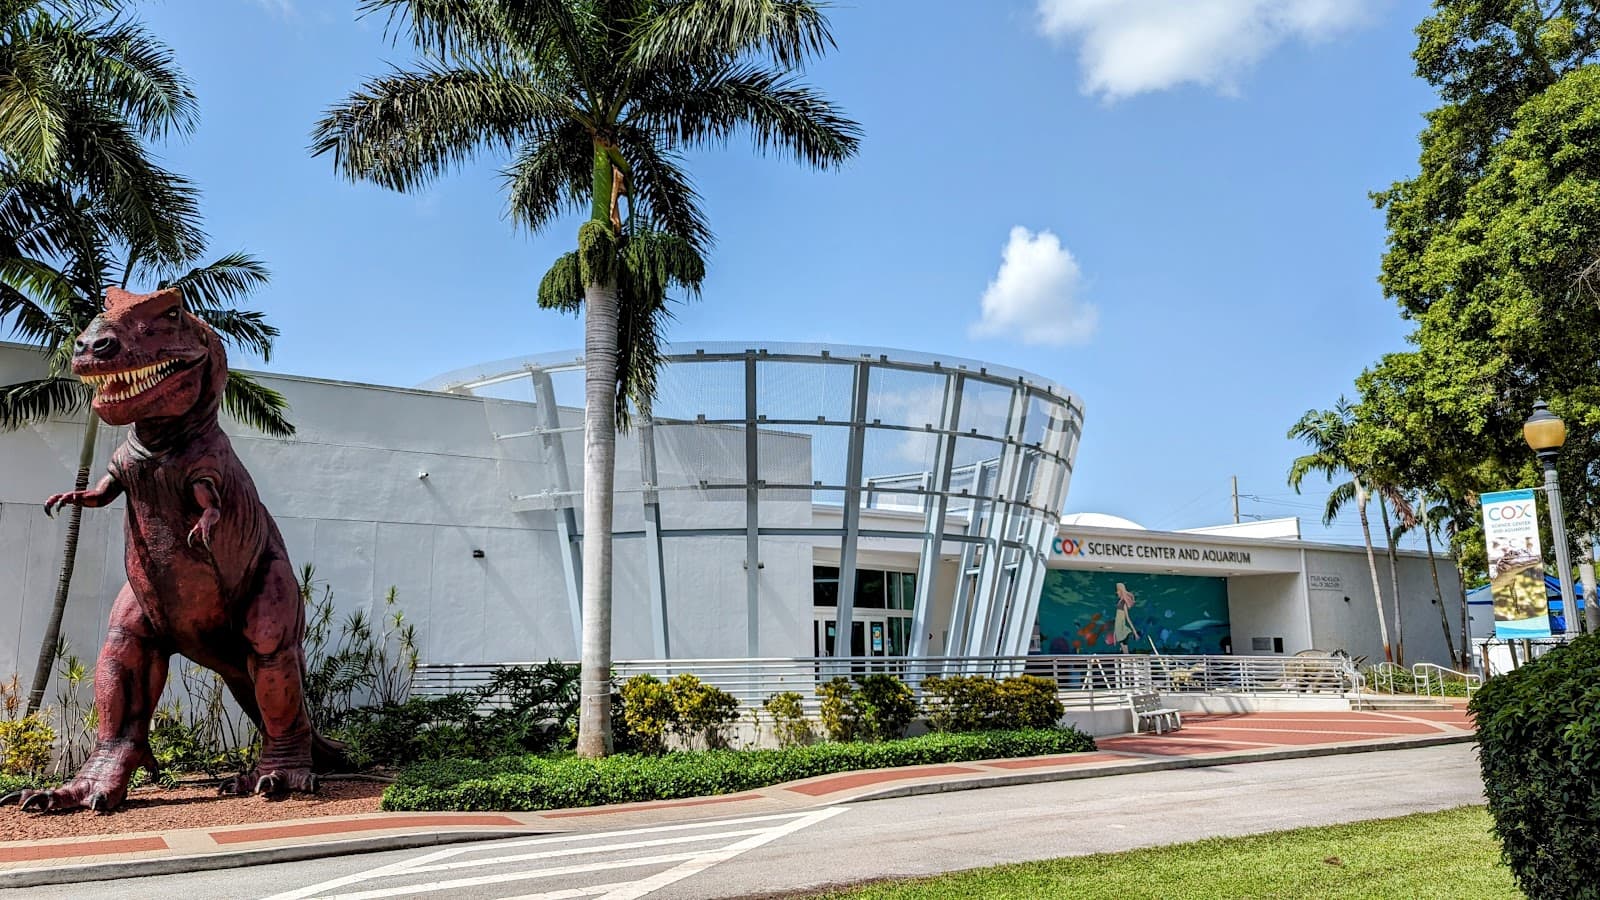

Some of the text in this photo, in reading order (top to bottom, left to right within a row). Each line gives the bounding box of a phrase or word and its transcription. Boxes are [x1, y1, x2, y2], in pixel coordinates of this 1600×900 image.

[1488, 503, 1532, 521] COX
[1052, 537, 1251, 564] COX SCIENCE CENTER AND AQUARIUM
